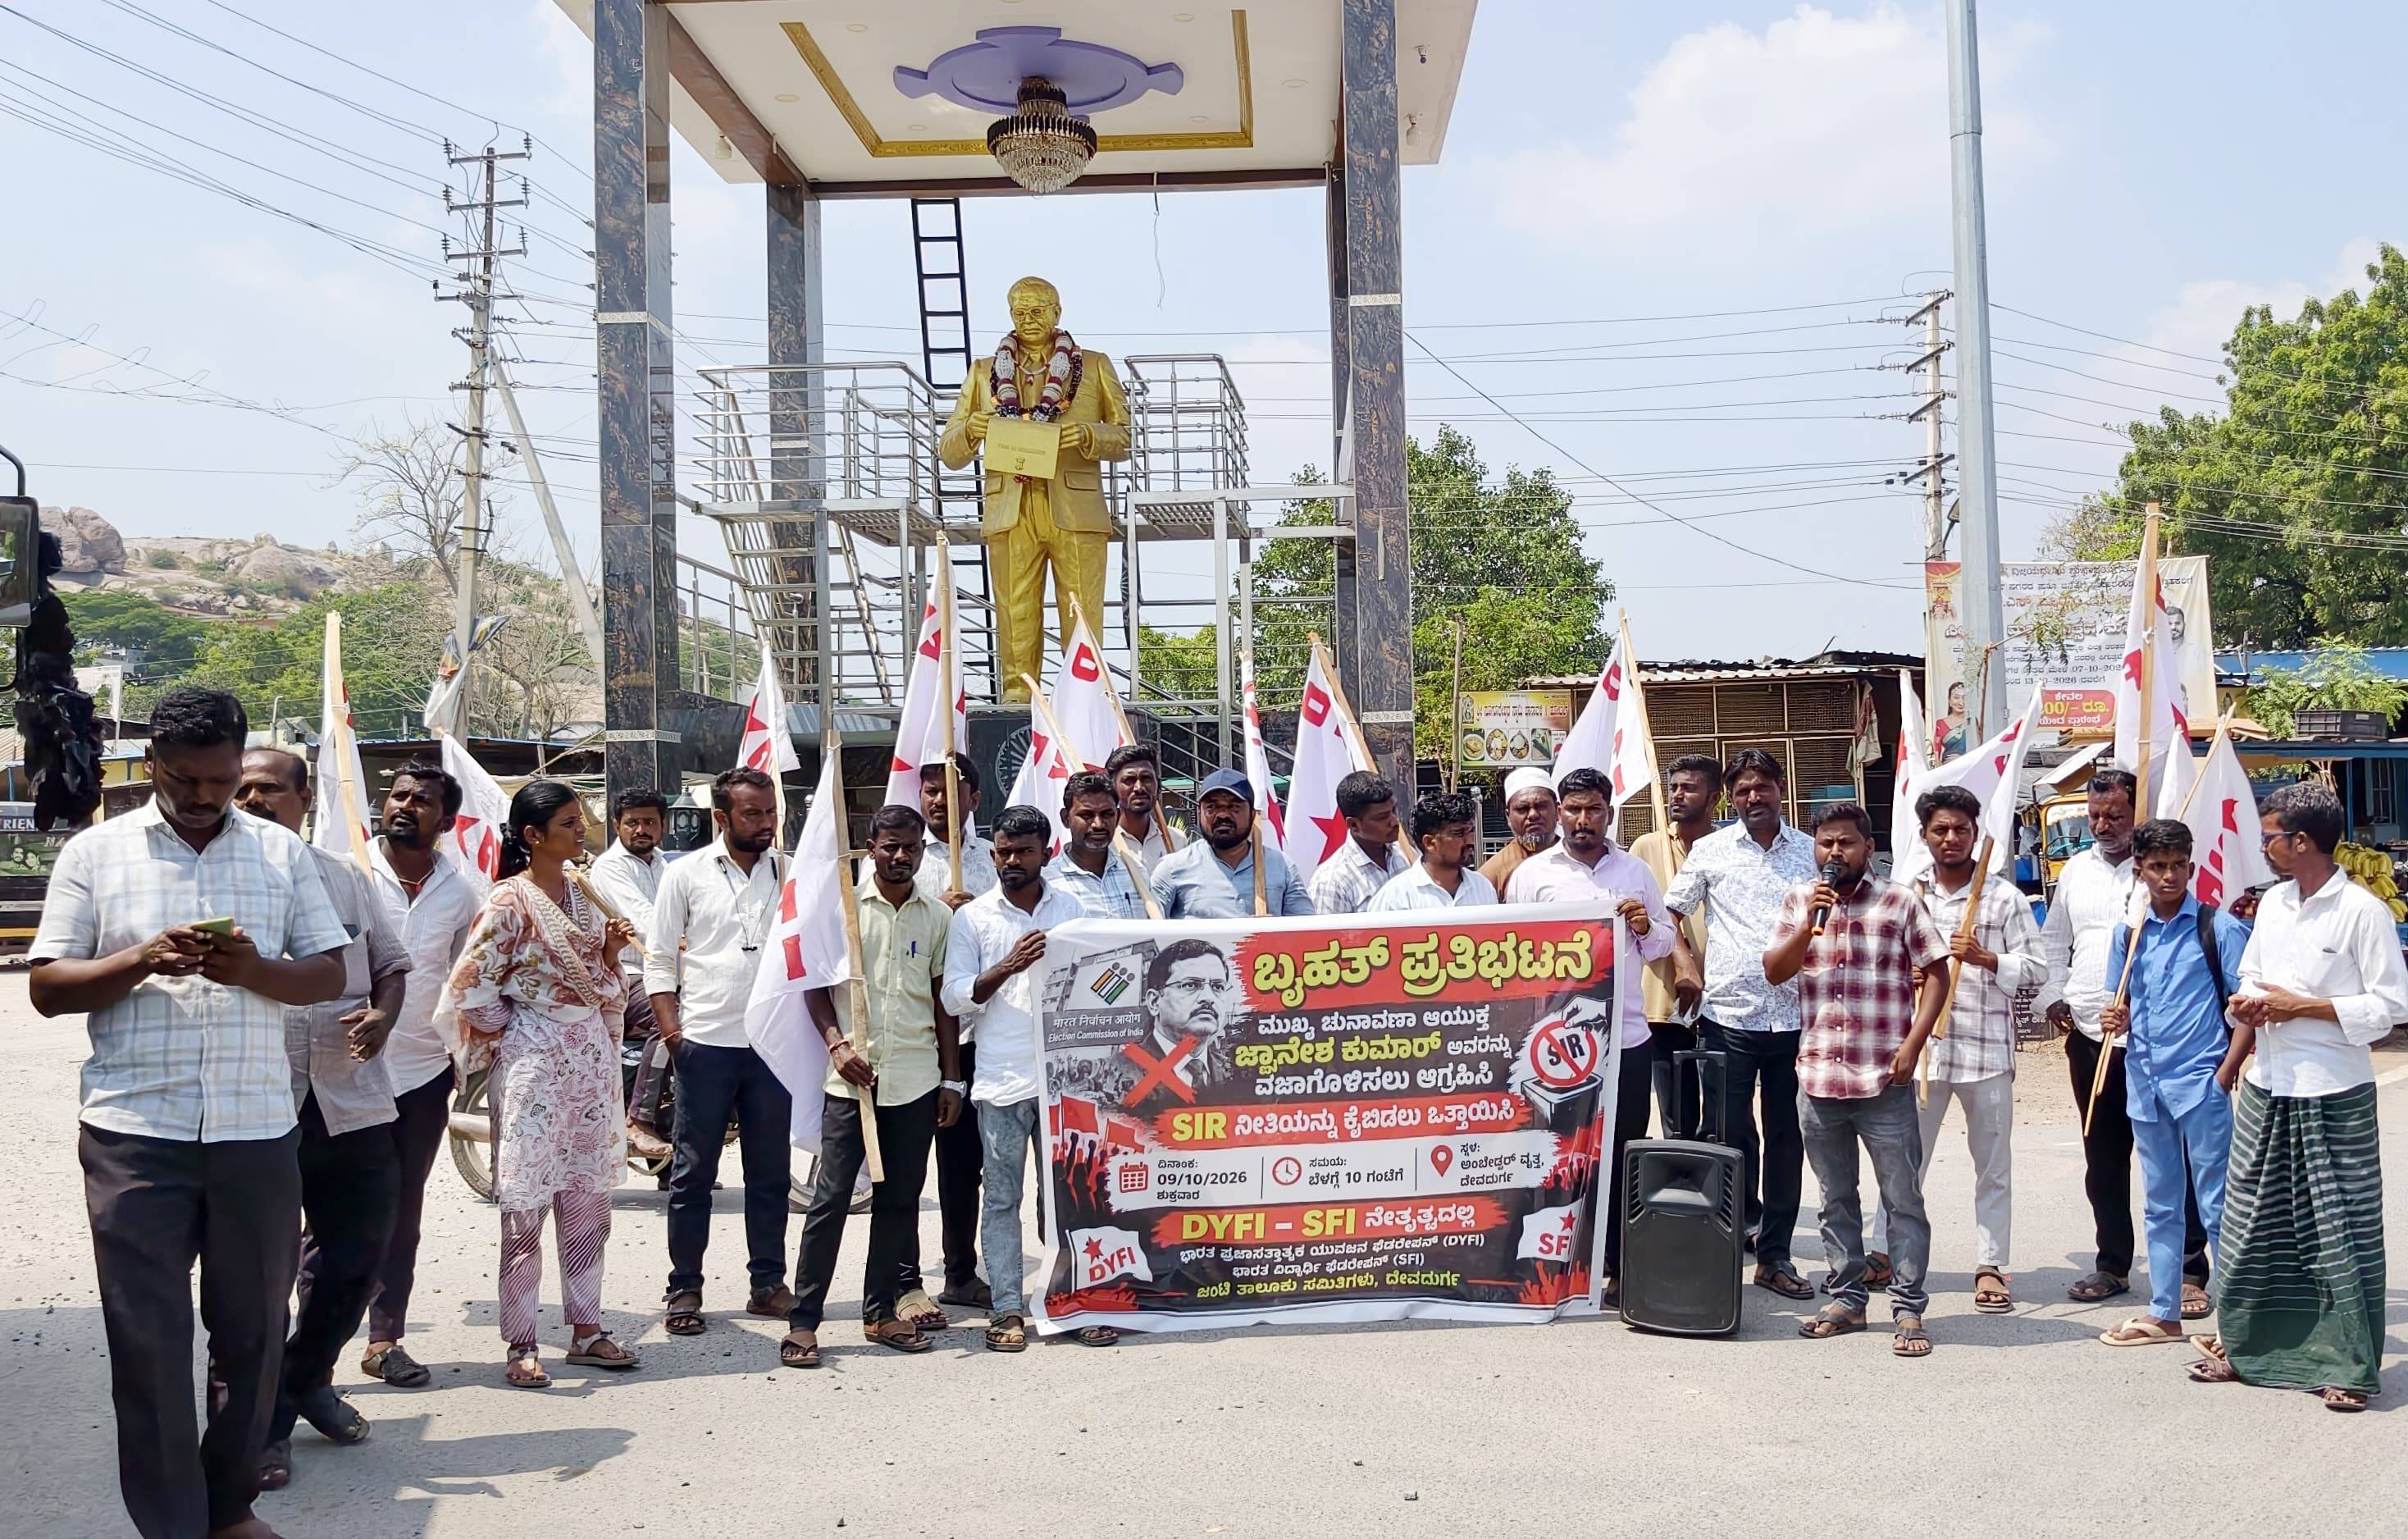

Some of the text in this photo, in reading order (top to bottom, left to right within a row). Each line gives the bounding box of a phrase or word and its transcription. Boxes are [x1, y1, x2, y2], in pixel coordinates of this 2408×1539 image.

[2023, 676, 2077, 684] 13-0-2026
[2072, 664, 2123, 673] 07-10-202
[1253, 929, 1592, 1007] ಬೃಹತ್ ಪ್ರತಿಭಟನೆ
[1053, 1012, 1142, 1029] भारत निर्वाचन आयोग
[1320, 1010, 1416, 1032] ಚುನಾವಣಾ
[1423, 1004, 1490, 1031] ಆಯುಕ್ತ
[1048, 1026, 1144, 1044] Election Commission of India
[1341, 1030, 1442, 1062] ಕುಮಾರ್
[1447, 1033, 1513, 1059] ಅವರನ್ನು
[1255, 1061, 1494, 1096] ವಜಾಗೊಳಿಸಲು ಆಗ್ರಹಿಸಿ
[1172, 1098, 1515, 1142] SIR ನೀತಿಯನ್ನು ಕೈಬಿಡಲು ಒತ್ತಾಯಿಸಿ
[1157, 1158, 1198, 1169] ದಿನಾಂಕ:
[1308, 1156, 1347, 1168] ಸಮಯ:
[1157, 1171, 1247, 1186] 09/10/2026
[1308, 1167, 1404, 1190] ಬೆಳಗ್ಗೆ 10 ಗಂಟೆಗೆ
[1460, 1171, 1514, 1191] ದೇವದುರ್ಗ
[1156, 1189, 1200, 1203] ಶುಕ್ರವಾರ
[1182, 1212, 1265, 1240] DYFI
[1301, 1208, 1357, 1237] SFI
[1179, 1246, 1216, 1264] ಭಾರತ
[1309, 1240, 1368, 1258] ಯುವಜನ
[1443, 1233, 1485, 1248] (DYFI)
[1089, 1246, 1137, 1282] DYFI
[1232, 1264, 1270, 1278] ಭಾರತ
[1393, 1252, 1425, 1267] (SFI)
[1196, 1269, 1461, 1299] ಜಂಟಿ ತಾಲೂಕು ಸಮಿತಿಗಳು, ದೇವದುರ್ಗ
